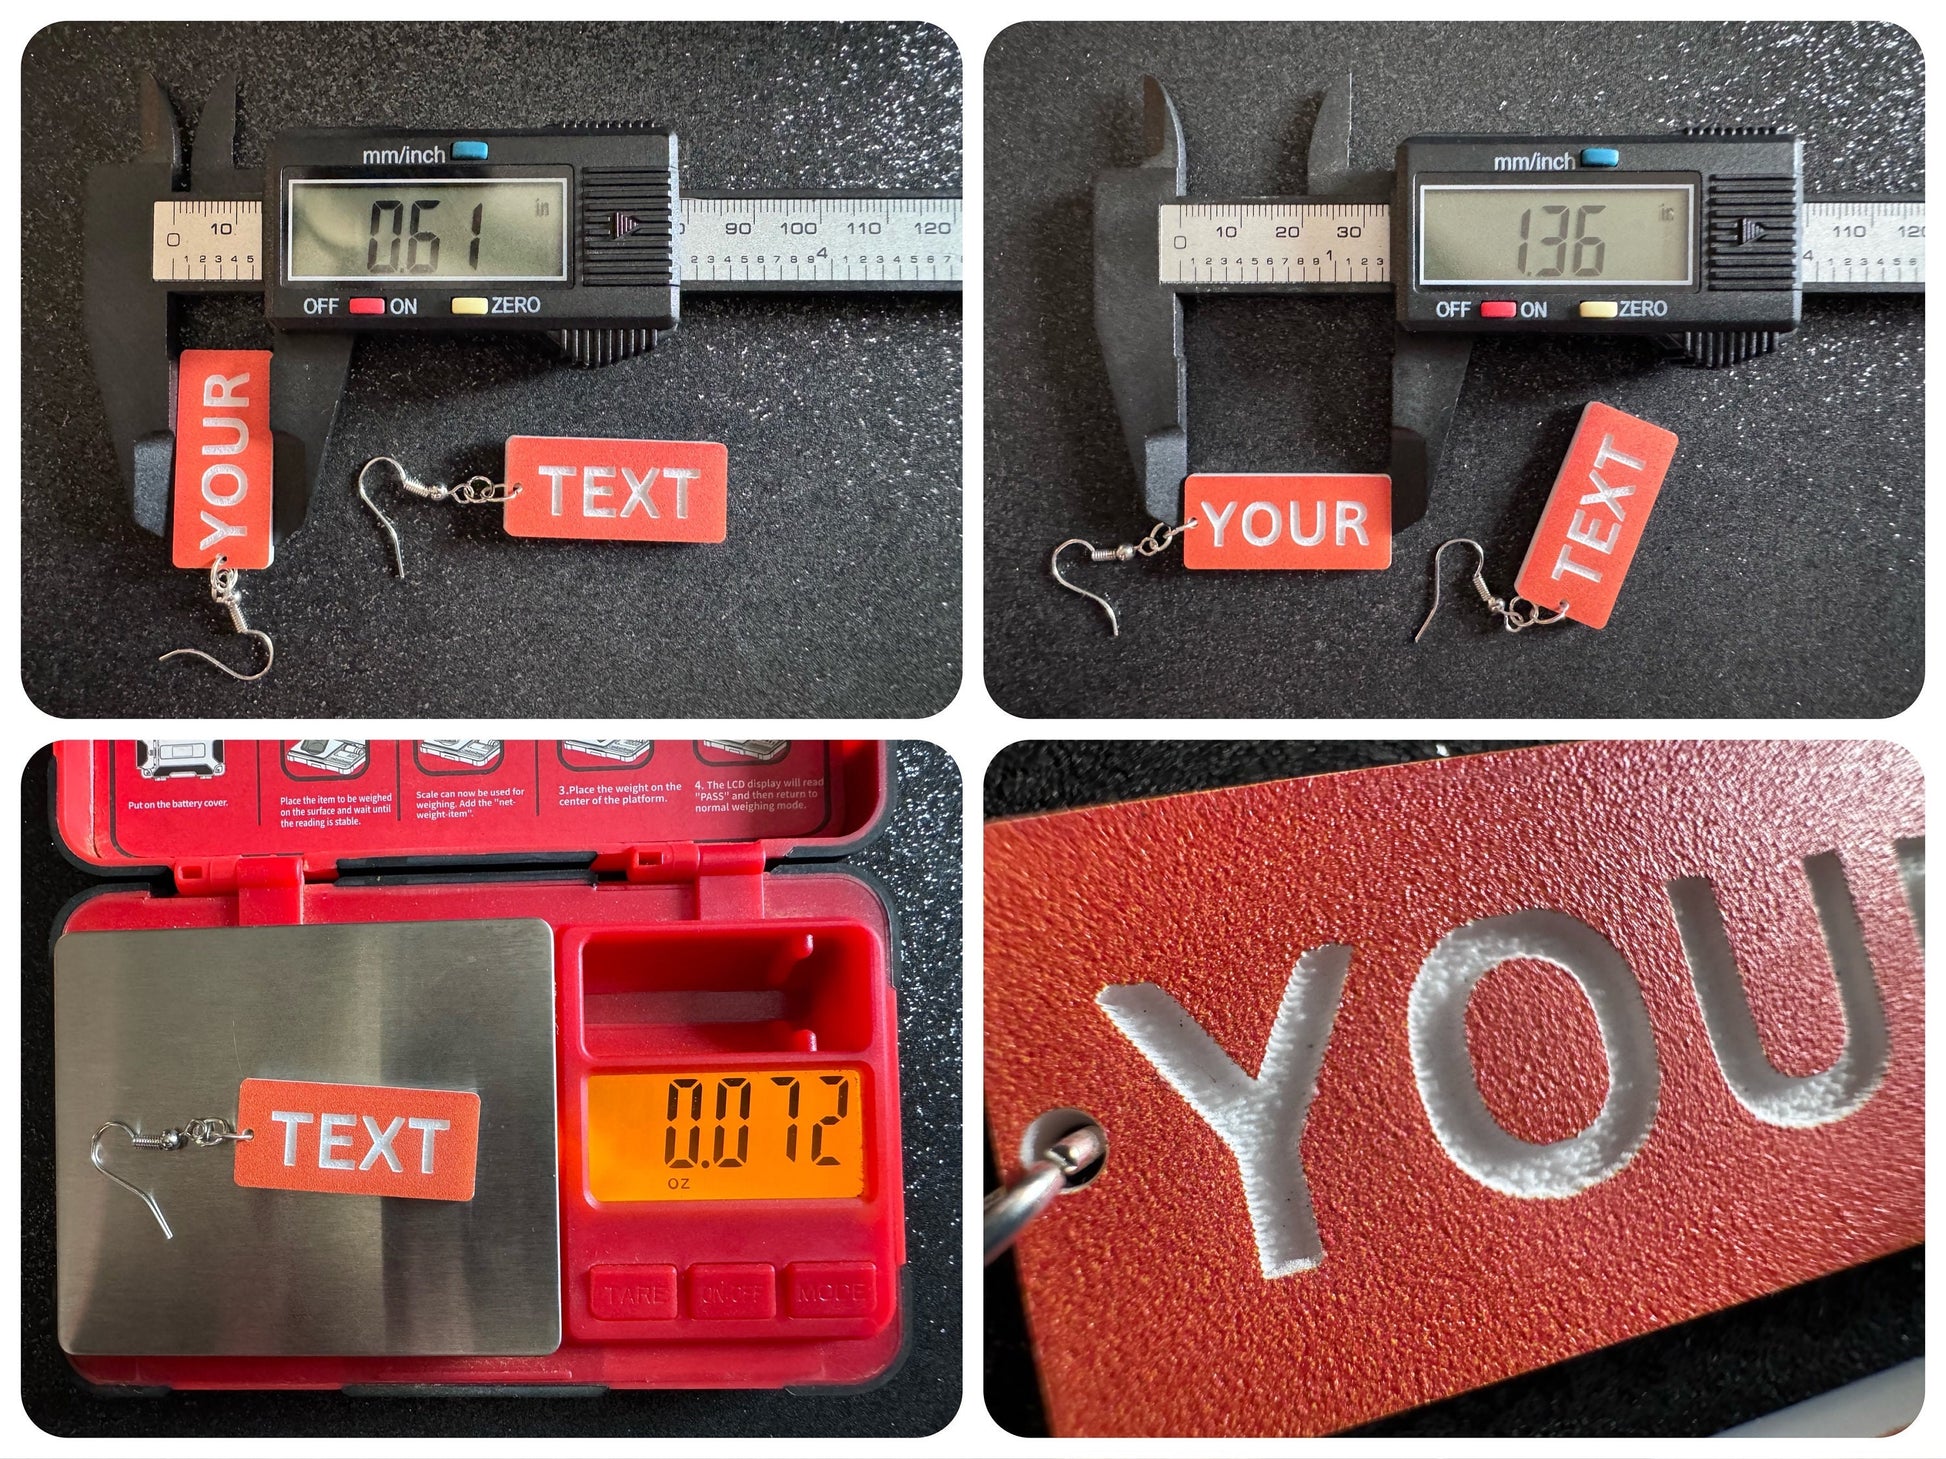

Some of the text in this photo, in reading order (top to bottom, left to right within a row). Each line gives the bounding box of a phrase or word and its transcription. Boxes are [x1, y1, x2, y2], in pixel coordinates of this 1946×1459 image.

[363, 145, 446, 165] mm/inch
[1494, 152, 1576, 171] mm/inch
[211, 223, 232, 235] 10
[725, 222, 951, 235] 90 100 110 120
[1216, 226, 1361, 238] 10 20 30
[1833, 226, 1867, 238] 110
[367, 198, 550, 274] 0.61 in
[1517, 204, 1607, 277] 1.36
[184, 255, 254, 263] 1 2 3 4 5
[690, 255, 815, 263] 2 3 4 5 6 7 8 9
[816, 247, 828, 259] 4
[843, 255, 848, 264] 1
[859, 255, 867, 264] 2
[876, 255, 884, 264] 3
[893, 255, 901, 264] 4
[910, 255, 918, 264] 5
[926, 255, 934, 264] 6
[943, 255, 951, 264] 7
[1326, 249, 1332, 261] 1
[1802, 249, 1814, 261] 4
[1190, 257, 1320, 265] 1 2 3 4 5 6 7 8 9
[1345, 257, 1384, 266] 1 2 3
[1827, 258, 1917, 266] 1 2 3 4 5 6
[303, 298, 340, 315] OFF
[390, 298, 418, 314] ON
[491, 297, 541, 314] ZERO
[1436, 302, 1472, 318] OFF
[1520, 302, 1548, 318] ON
[1619, 301, 1668, 317] ZERO
[200, 372, 251, 550] YOUR
[538, 465, 701, 520] TEXT
[1551, 433, 1647, 583] TEXT
[1201, 500, 1369, 547] YOUR
[558, 782, 682, 795] 3.Place the weight on the
[694, 777, 824, 790] 4. The LCD display will read
[280, 797, 301, 805] Place
[303, 796, 316, 804] the
[317, 795, 336, 804] item
[347, 794, 357, 803] be
[359, 793, 392, 804] weighed
[416, 791, 439, 799] Scale
[478, 789, 488, 797] be
[490, 788, 511, 796] used
[512, 787, 525, 796] for
[695, 790, 818, 801] "PASS" and then return to
[128, 801, 143, 810] Put
[157, 800, 170, 809] the
[172, 799, 202, 809] battery
[204, 799, 228, 807] cover.
[416, 798, 516, 810] weighing. Add the "net-
[559, 794, 668, 806] center of the platform.
[695, 800, 807, 813] normal weighing mode.
[292, 807, 305, 816] the
[307, 806, 335, 816] surface
[337, 806, 352, 814] and
[354, 805, 371, 814] wait
[373, 804, 391, 813] until
[416, 809, 474, 820] weight-item".
[280, 817, 361, 829] the reading is stable.
[1095, 836, 1926, 1281] YOU
[664, 1075, 849, 1169] 0.072
[271, 1111, 451, 1175] TEXT
[604, 1286, 669, 1305] TARE
[799, 1283, 865, 1303] MODE
